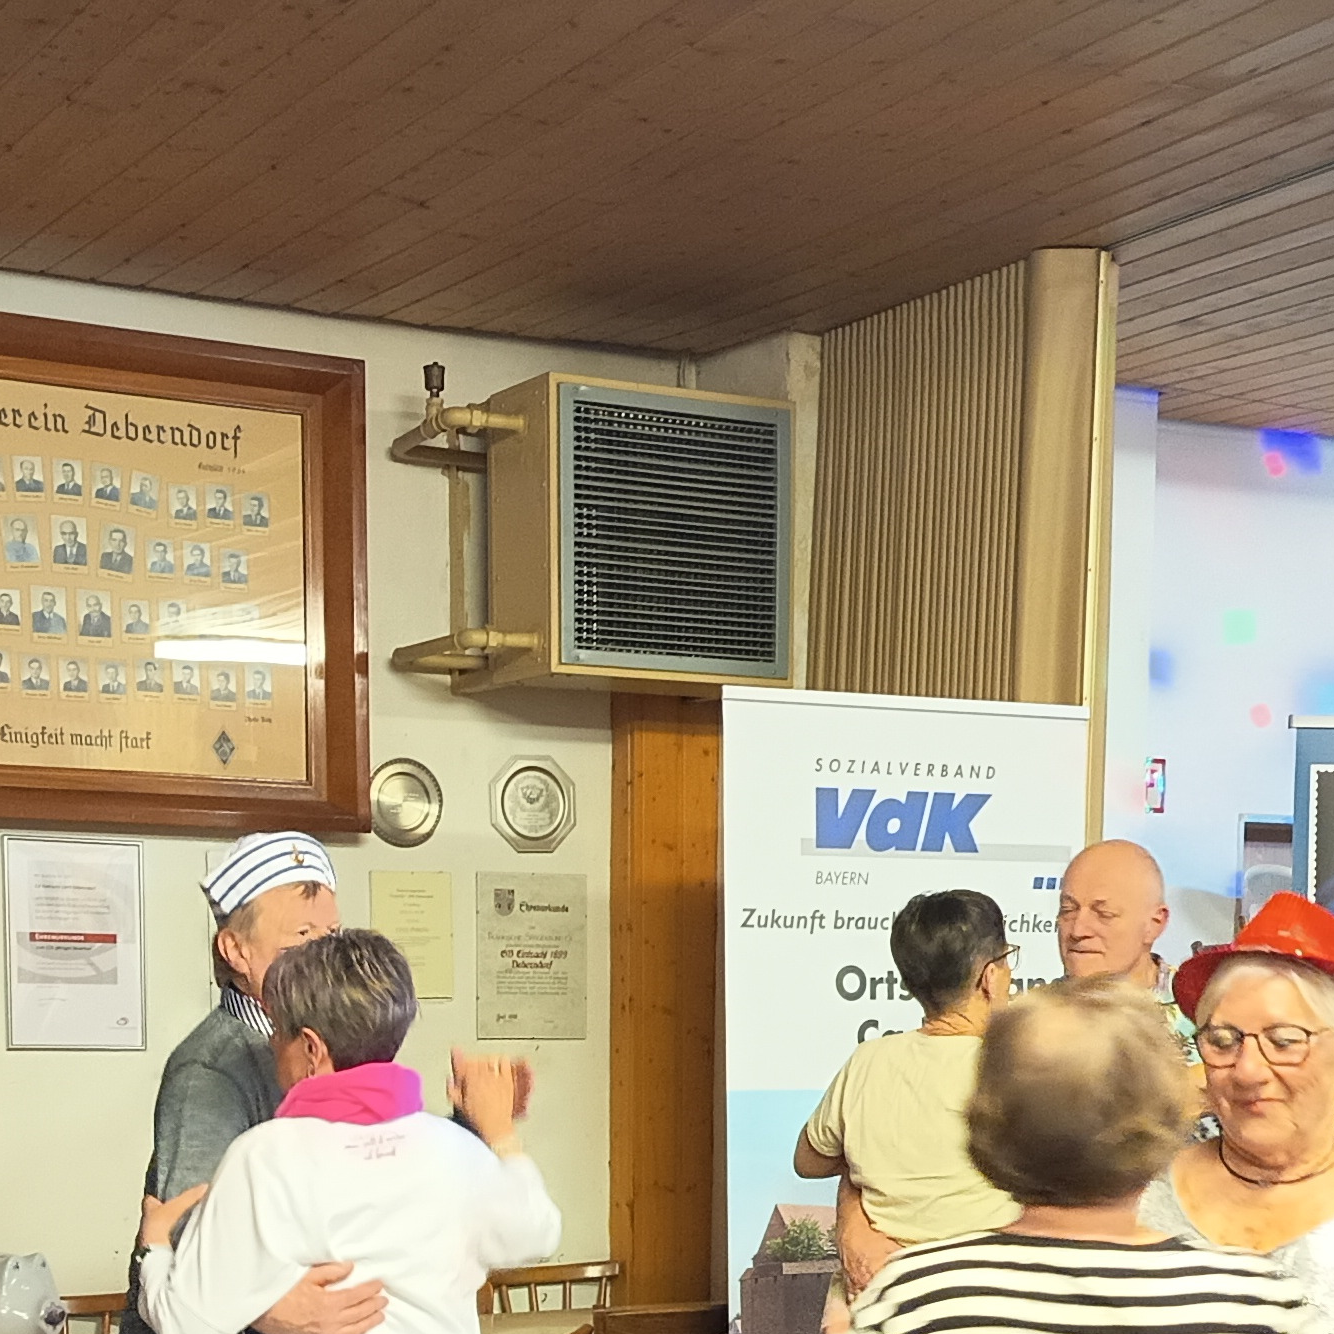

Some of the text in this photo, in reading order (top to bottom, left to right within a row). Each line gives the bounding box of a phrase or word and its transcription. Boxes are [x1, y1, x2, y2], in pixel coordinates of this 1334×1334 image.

[81, 403, 243, 458] Deberndorf
[70, 728, 114, 751] macht
[815, 757, 997, 780] SOZIALVERBAND
[815, 787, 992, 853] VdK
[815, 871, 869, 886] BAYERN
[740, 908, 826, 934] Zukunft
[833, 910, 896, 931] brauc
